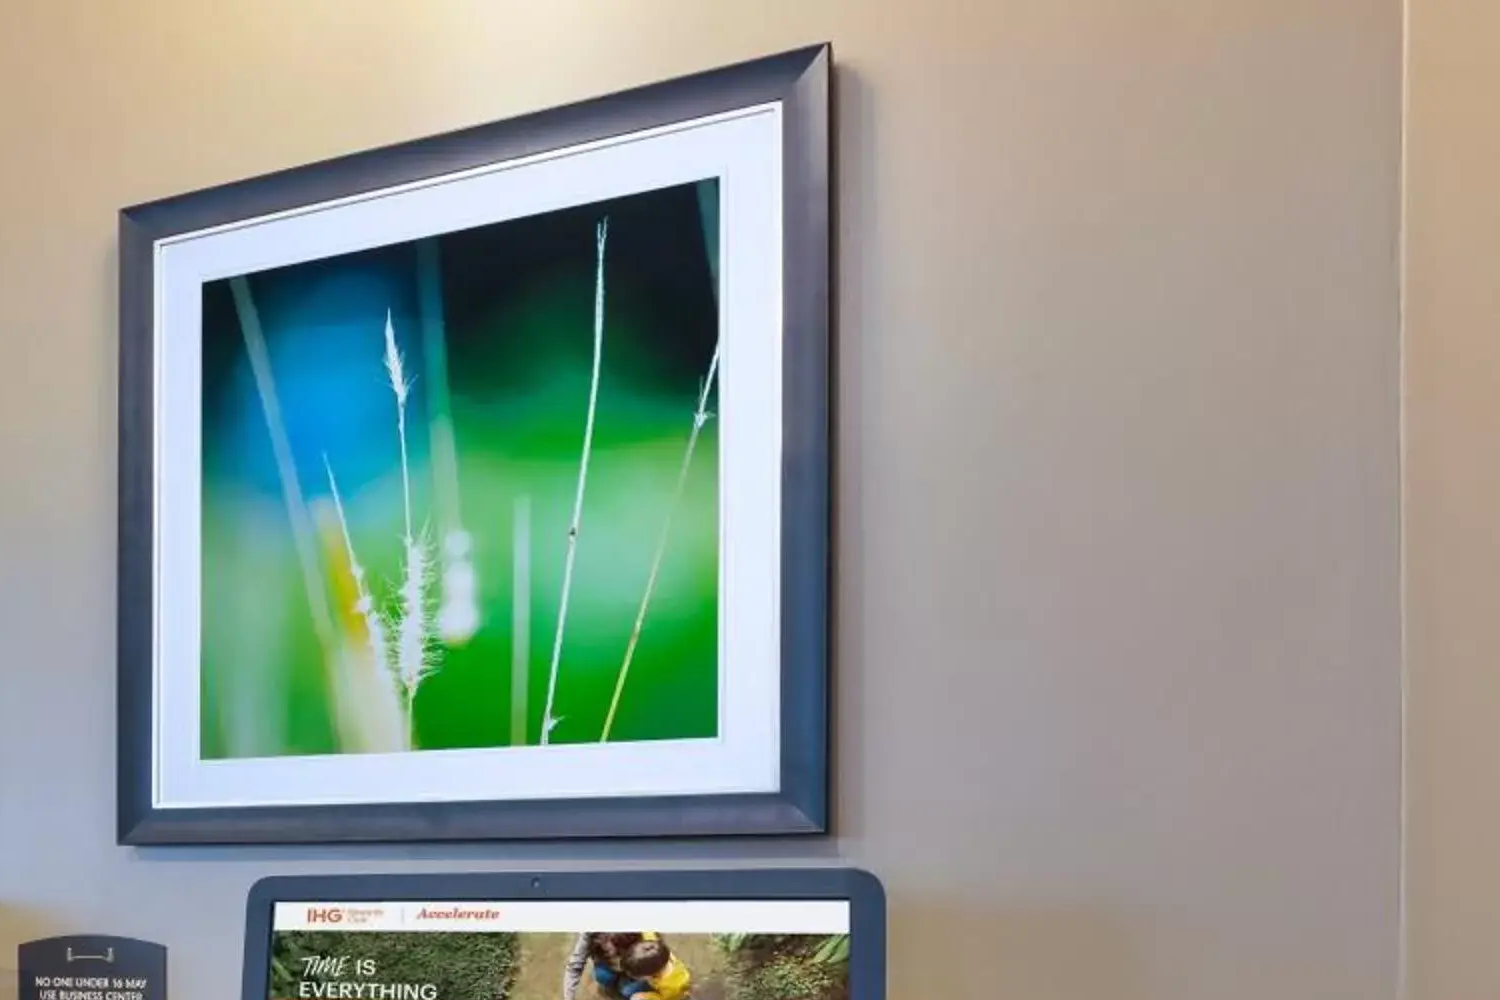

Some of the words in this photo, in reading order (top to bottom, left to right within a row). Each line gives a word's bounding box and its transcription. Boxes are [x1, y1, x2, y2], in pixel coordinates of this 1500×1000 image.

[307, 908, 343, 924] IHG
[416, 907, 501, 921] Accelerate
[301, 955, 351, 977] TIME
[356, 959, 377, 975] IS
[35, 976, 50, 987] NO
[53, 976, 73, 987] ONE
[75, 977, 109, 988] UNDER
[125, 978, 148, 989] MAY
[39, 990, 57, 1000] USE
[299, 981, 438, 1000] EVERYTHING
